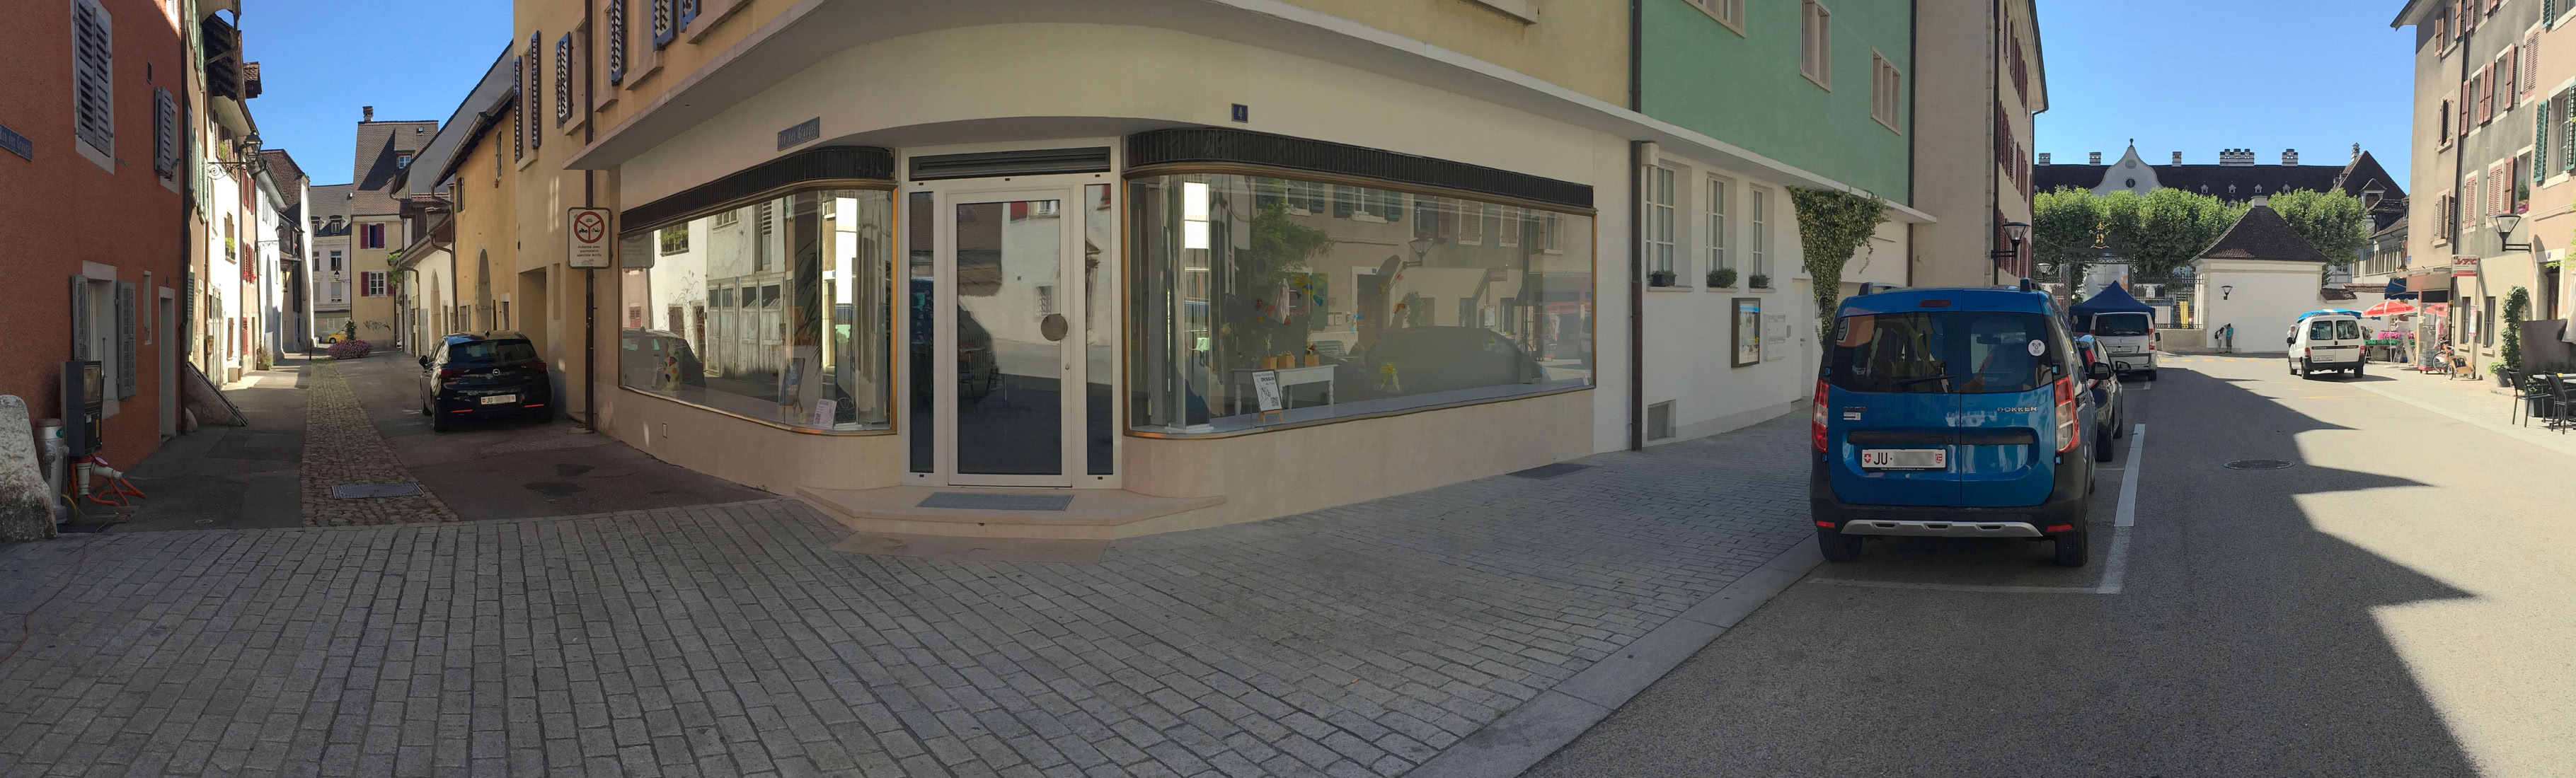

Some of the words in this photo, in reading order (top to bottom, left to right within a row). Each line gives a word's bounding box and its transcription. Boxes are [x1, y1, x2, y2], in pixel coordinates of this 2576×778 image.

[1238, 107, 1243, 120] 4
[778, 133, 787, 146] Rue
[798, 124, 817, 140] Granges
[1873, 452, 1887, 465] JU
